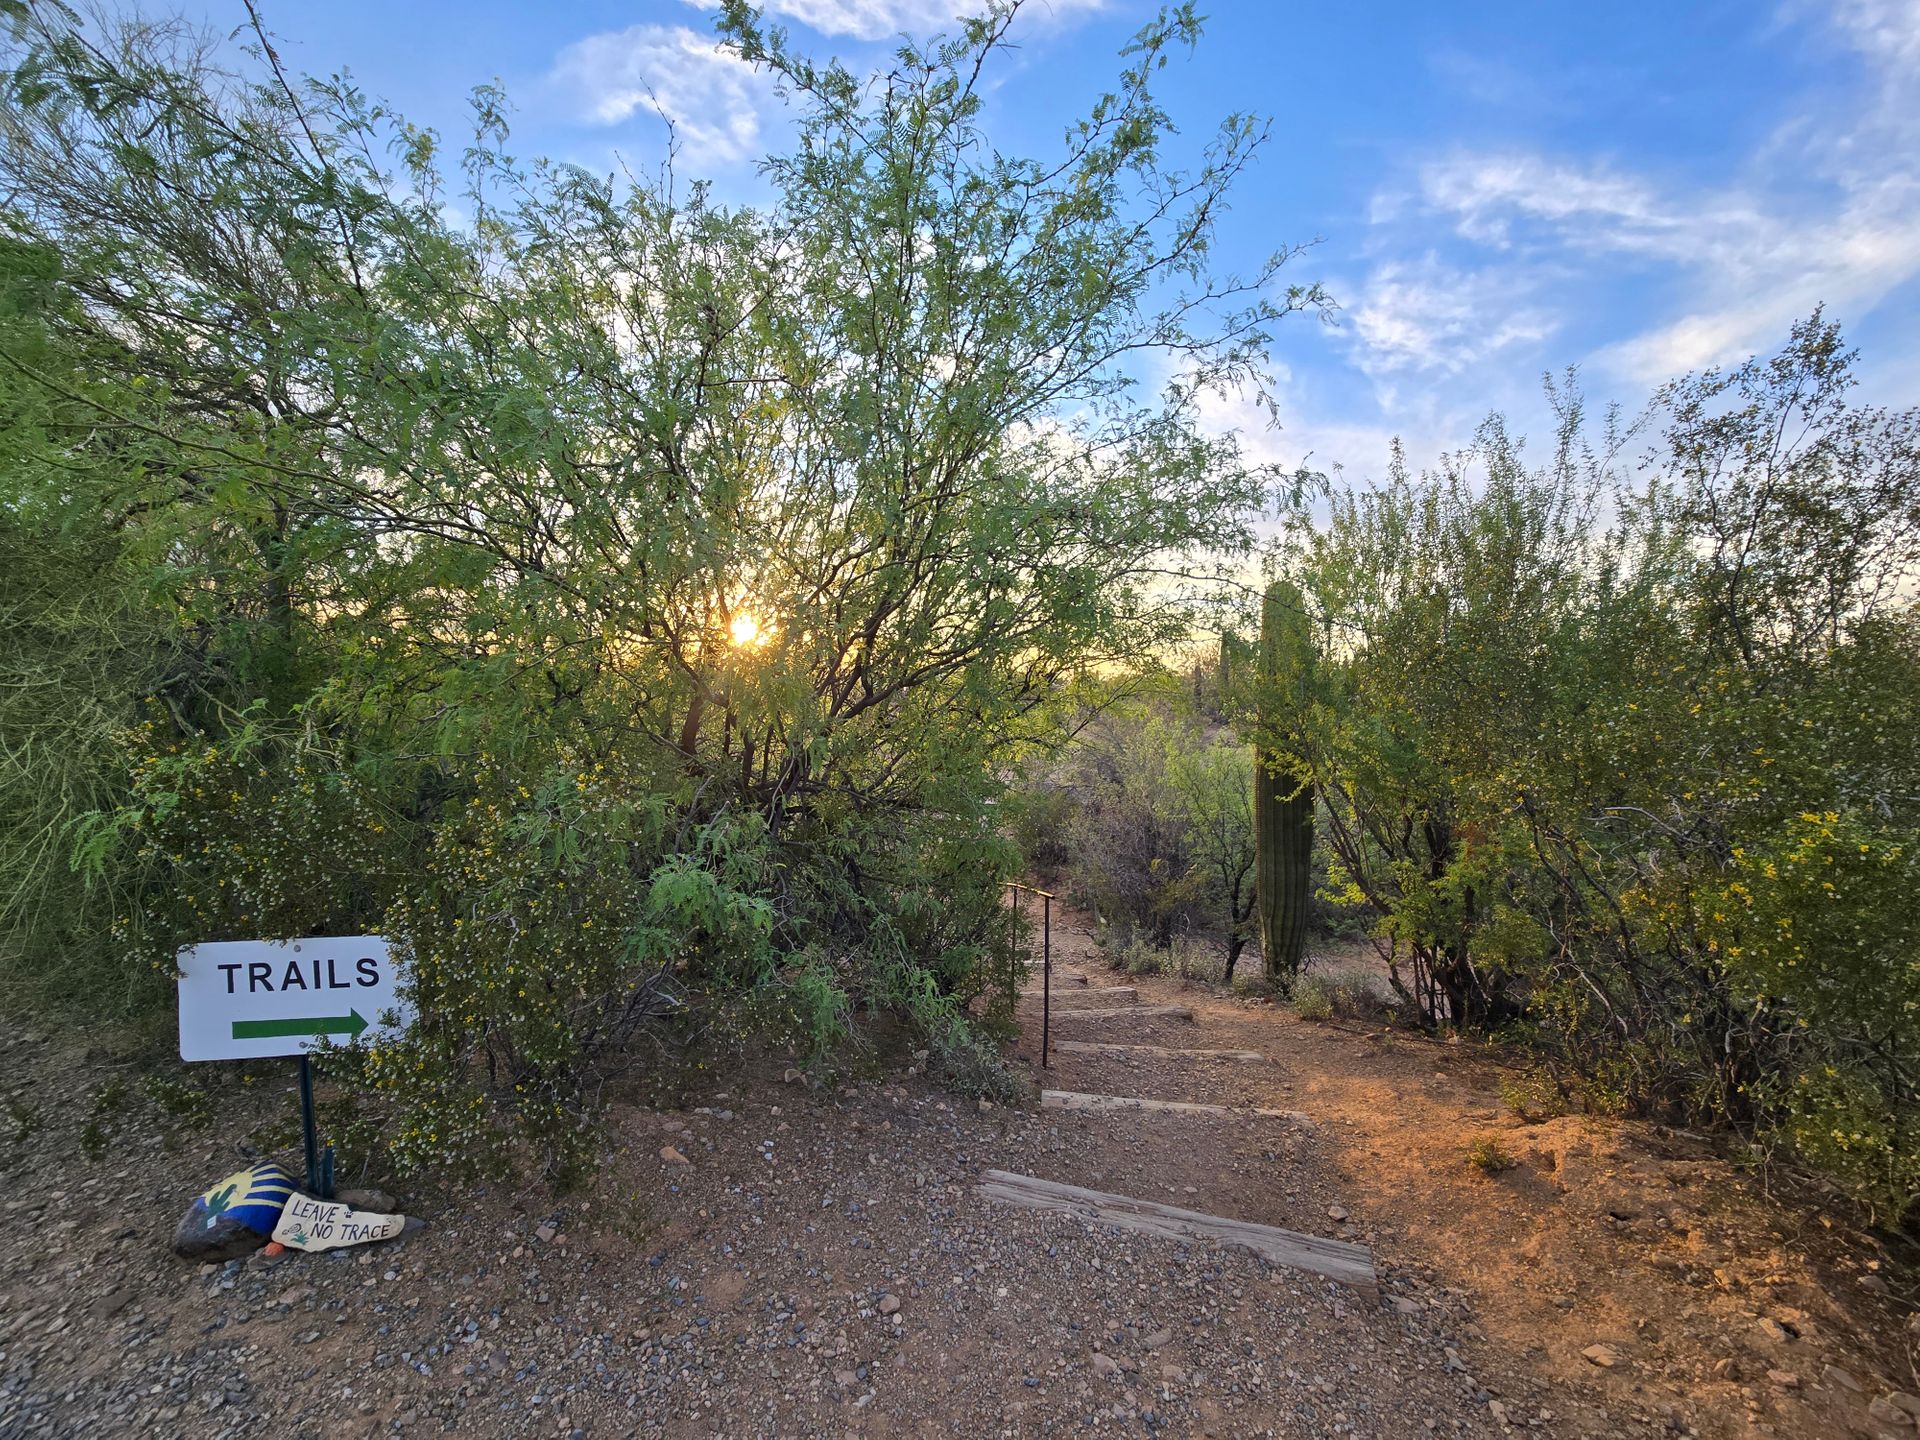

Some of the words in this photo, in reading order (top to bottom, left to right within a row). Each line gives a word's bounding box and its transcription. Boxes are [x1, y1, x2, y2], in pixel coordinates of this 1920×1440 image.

[217, 958, 379, 993] TRAILS
[292, 1200, 339, 1223] LEAVE
[310, 1223, 333, 1239] NO
[340, 1224, 391, 1240] TRACE
